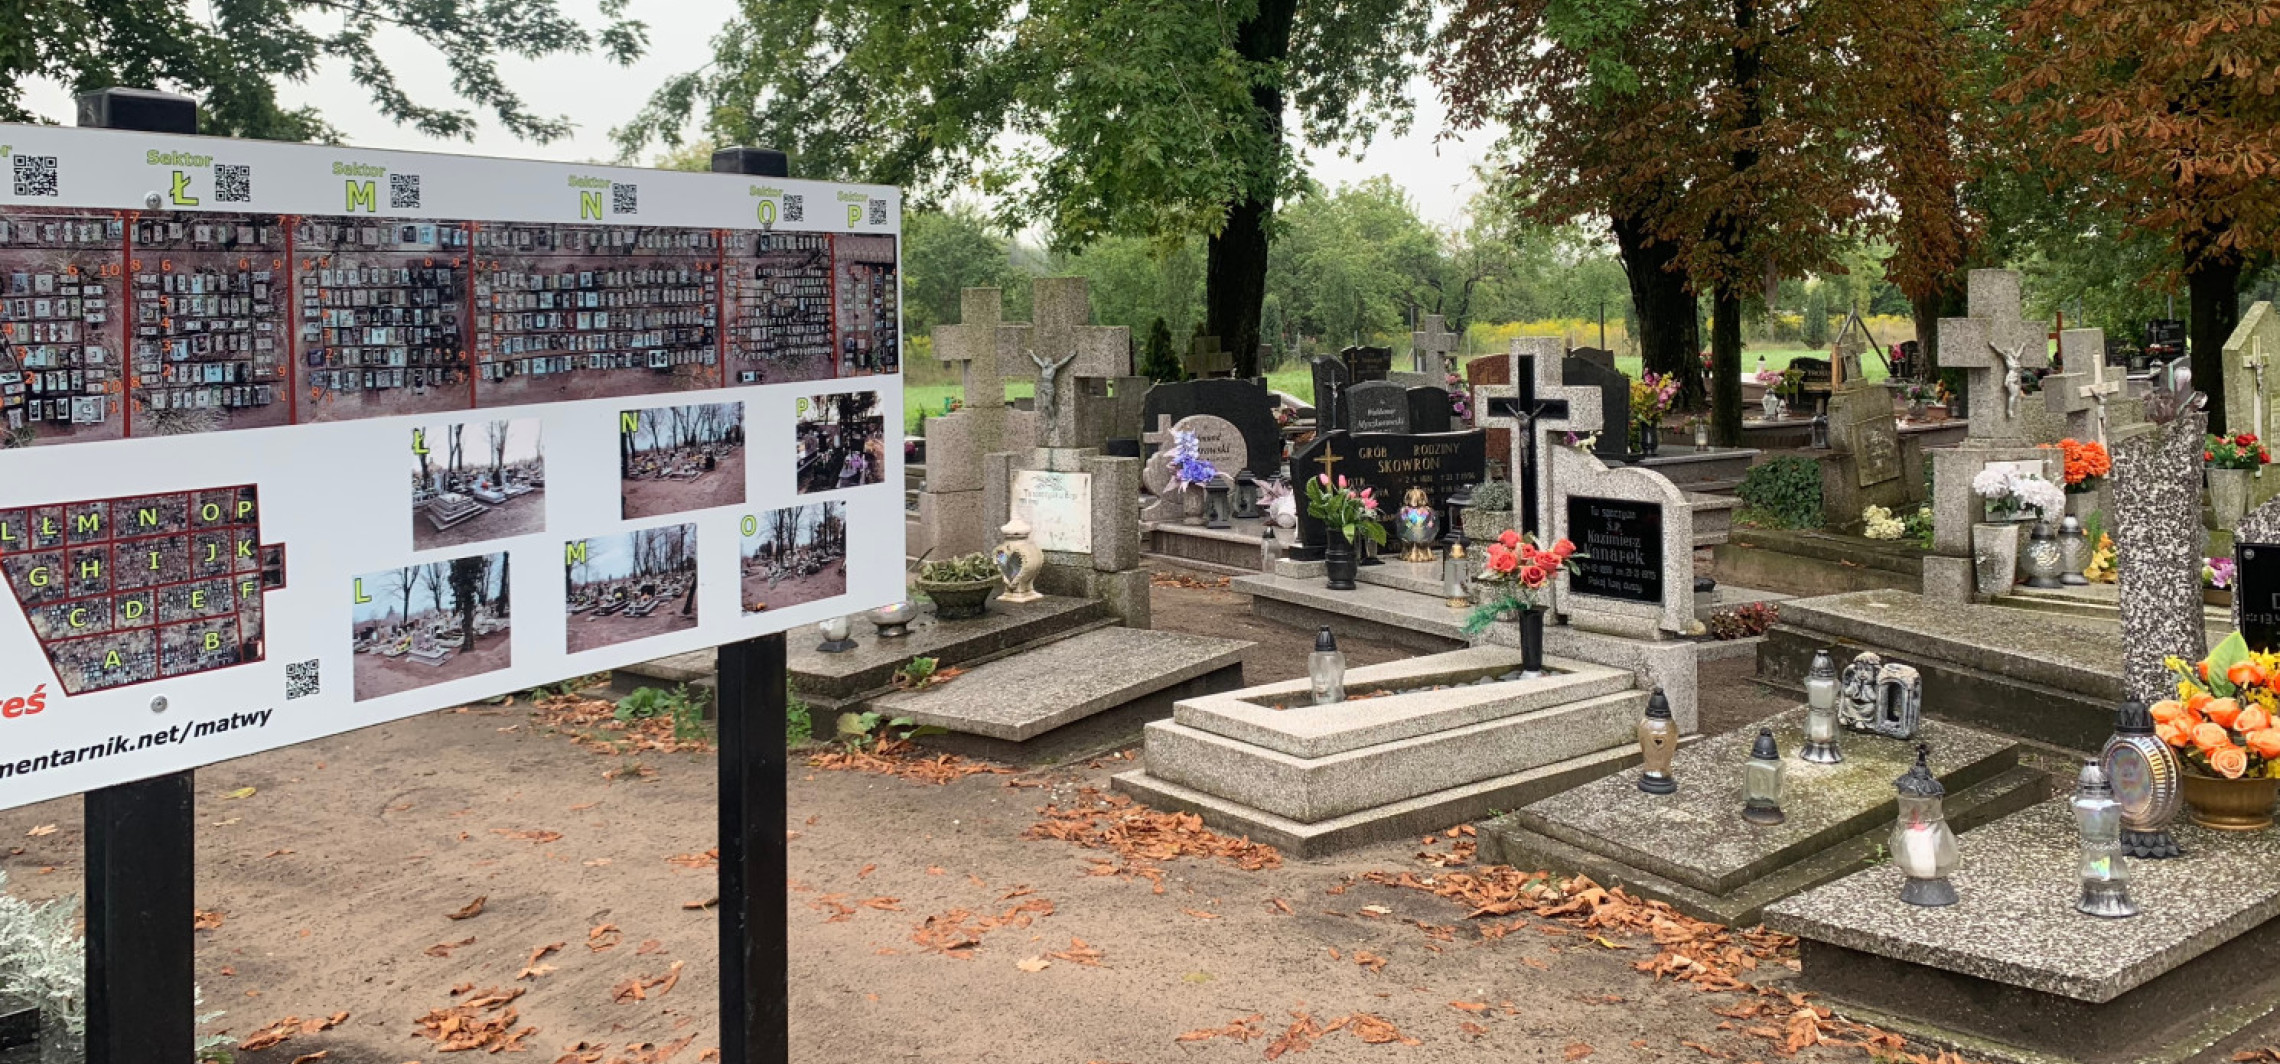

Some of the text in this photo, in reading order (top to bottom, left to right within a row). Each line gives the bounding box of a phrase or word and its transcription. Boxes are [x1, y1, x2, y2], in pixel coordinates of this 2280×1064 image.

[147, 149, 213, 167] Sektor
[332, 161, 386, 177] Sektor
[169, 170, 199, 206] Ł
[346, 180, 376, 213] M
[581, 191, 602, 220] N
[758, 200, 776, 225] O
[848, 205, 862, 228] P
[100, 265, 120, 276] 10
[162, 260, 171, 271] 6
[273, 259, 282, 270] 9
[24, 371, 35, 384] 2
[278, 366, 286, 377] 9
[796, 398, 808, 418] P
[622, 410, 639, 434] N
[411, 429, 430, 456] Ł
[1358, 442, 1460, 459] GRÓB RODZINY
[1378, 457, 1440, 473] SKOWRON
[140, 508, 157, 527] N
[202, 504, 220, 522] O
[238, 500, 252, 519] P
[1, 522, 16, 541] L
[42, 516, 58, 536] Ł
[78, 513, 99, 533] M
[740, 515, 757, 536] O
[206, 545, 217, 563] J
[238, 540, 252, 557] K
[565, 541, 587, 566] M
[81, 560, 99, 580] H
[149, 552, 160, 570] I
[28, 566, 49, 587] G
[191, 590, 205, 609] E
[242, 582, 254, 600] F
[354, 578, 372, 605] L
[69, 608, 87, 628] C
[125, 600, 144, 620] D
[205, 632, 220, 651] B
[104, 650, 122, 670] A
